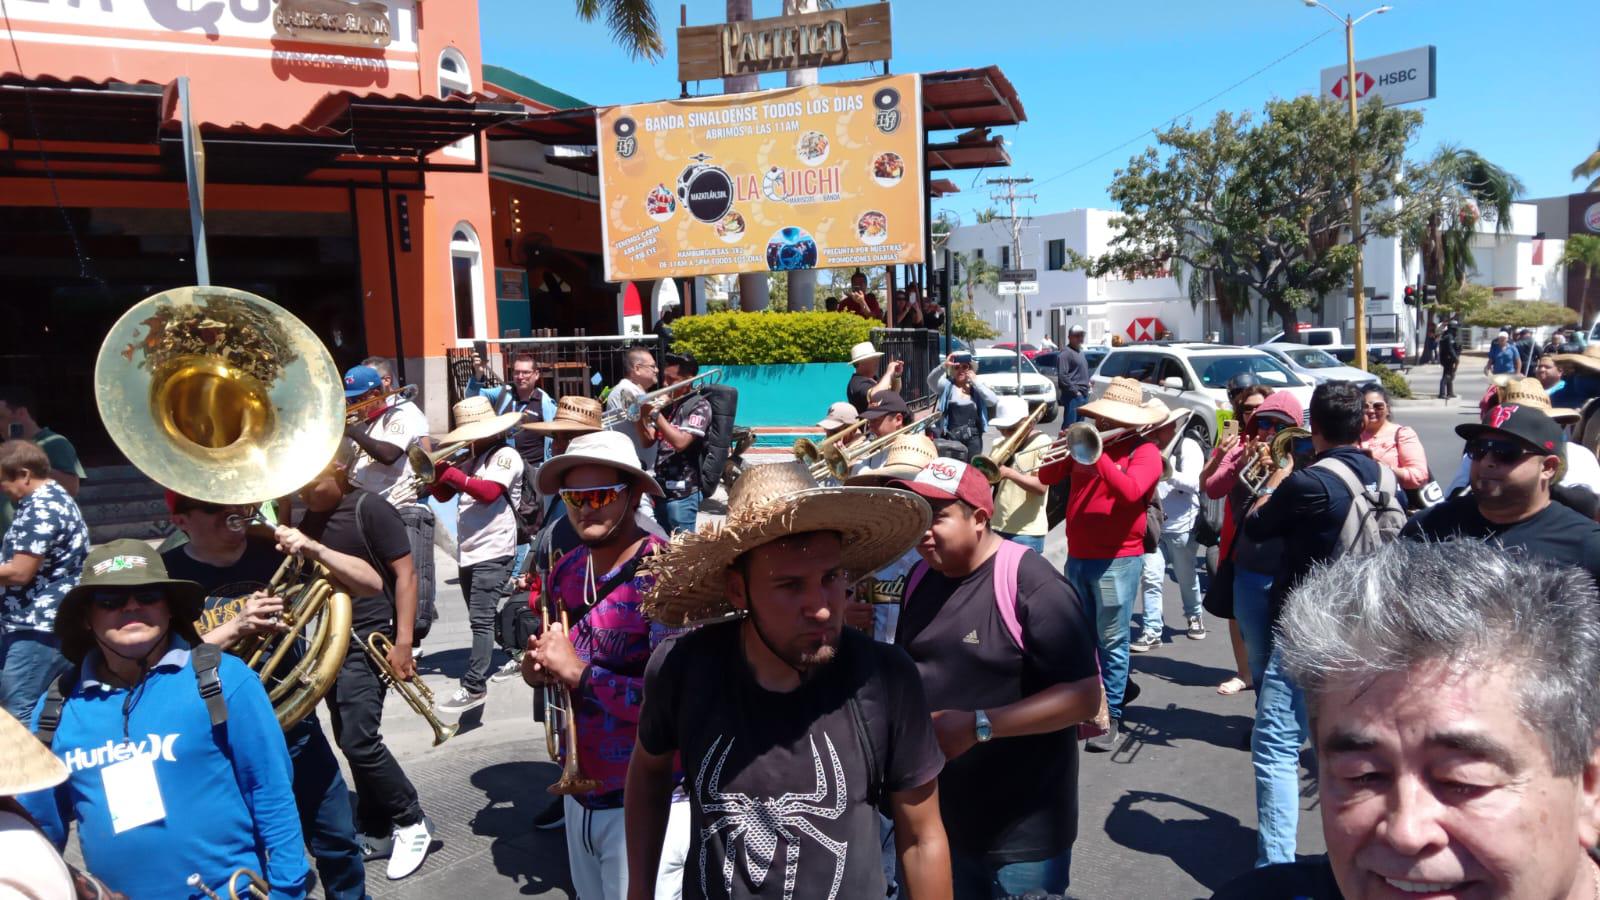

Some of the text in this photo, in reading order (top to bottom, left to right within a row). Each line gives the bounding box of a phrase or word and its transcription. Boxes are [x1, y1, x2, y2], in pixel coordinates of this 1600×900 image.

[1379, 68, 1416, 86] HSBC
[645, 95, 864, 131] BANDA SINALOENSE TODOS LOS DIAS
[706, 127, 744, 140] ABRIMOS
[756, 123, 771, 134] LAS
[775, 121, 799, 132] 11AM
[736, 175, 760, 201] LA
[65, 739, 149, 774] Hurley
